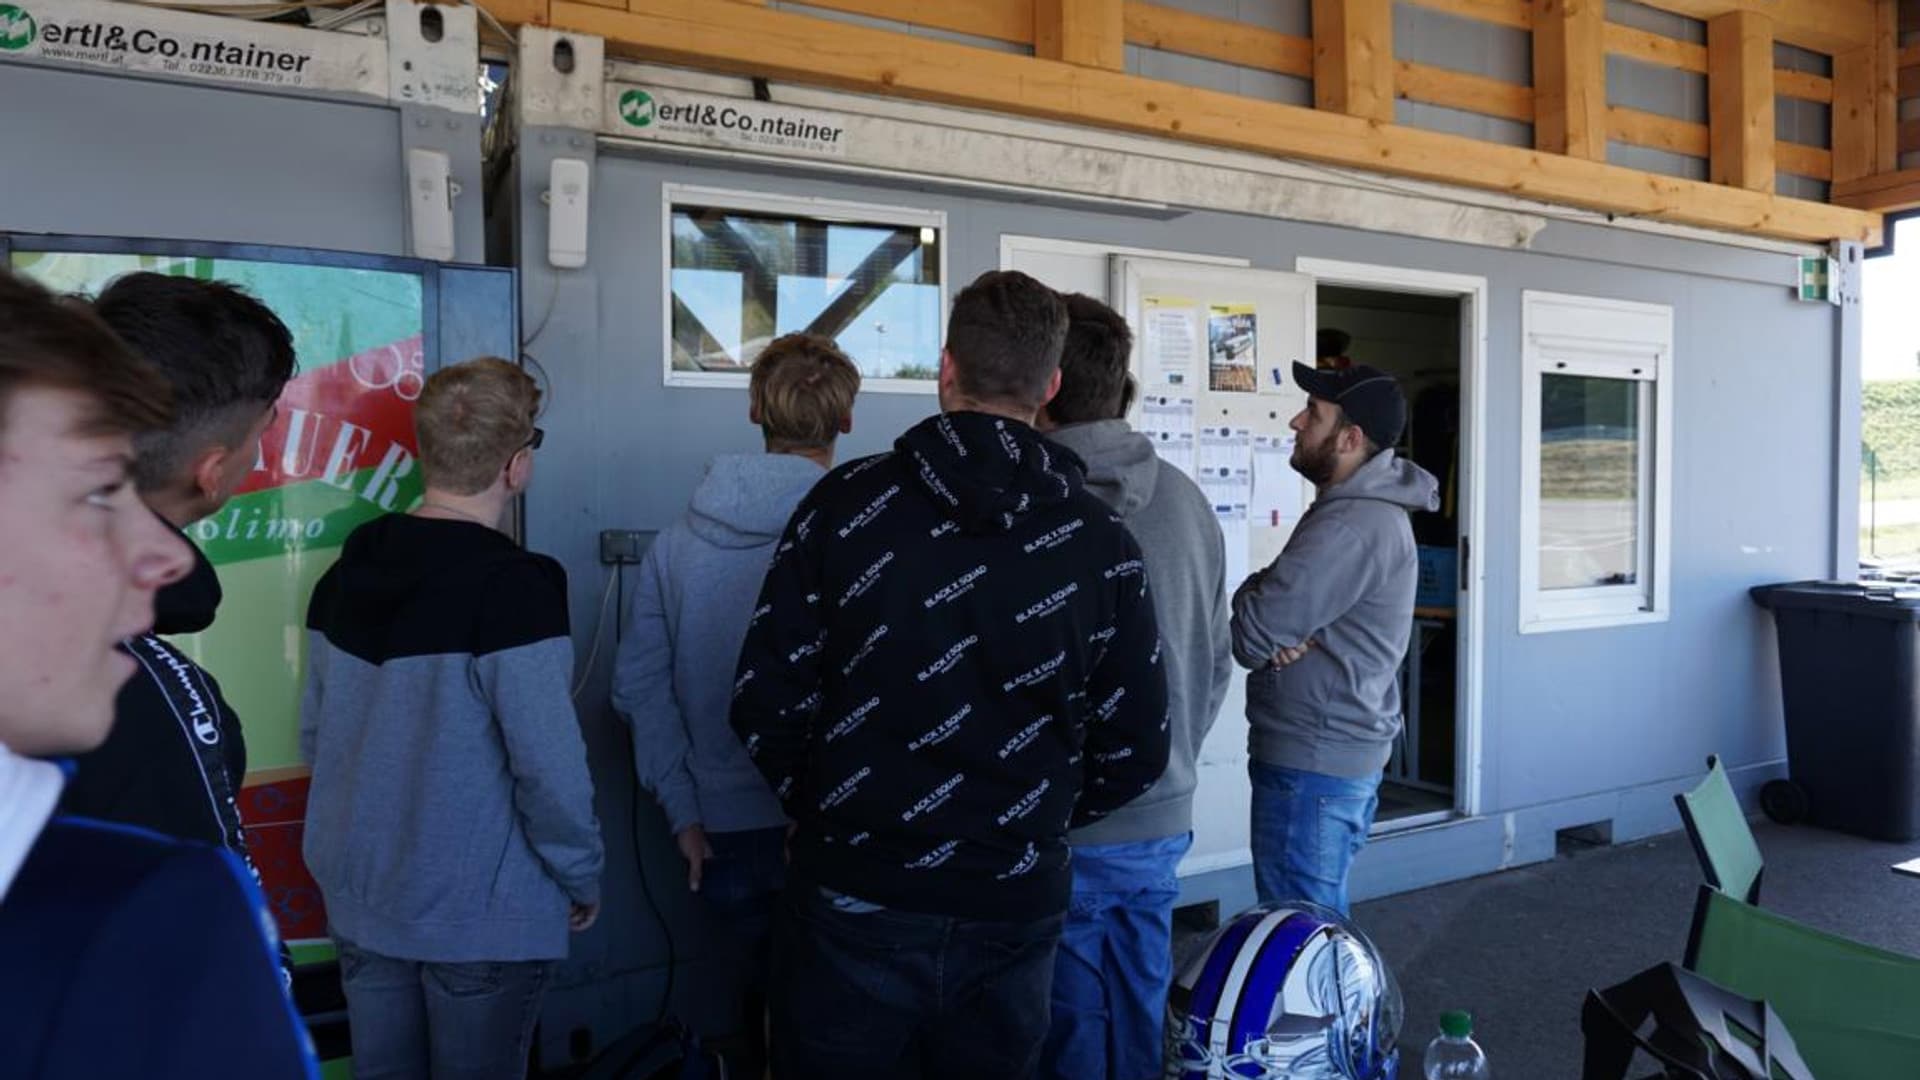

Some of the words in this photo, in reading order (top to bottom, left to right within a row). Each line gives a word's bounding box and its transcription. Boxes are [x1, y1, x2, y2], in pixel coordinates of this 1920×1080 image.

[838, 513, 869, 538] BLACK
[871, 485, 900, 509] SQUAD
[1024, 534, 1055, 552] BLACK
[1057, 519, 1083, 536] SQUAD
[866, 552, 894, 577] SQUAD
[924, 586, 952, 607] BLACK
[958, 565, 987, 585] SQUAD
[1016, 602, 1047, 623] BLACK
[1051, 583, 1078, 602] SQUAD
[918, 657, 949, 681] BLACK
[949, 635, 978, 656] SQUAD
[1003, 672, 1034, 691] BLACK
[852, 697, 880, 719] SQUAD
[908, 729, 939, 751] BLACK
[944, 704, 971, 728] SQUAD
[902, 797, 934, 821] BLACK
[935, 774, 964, 796] SQUAD
